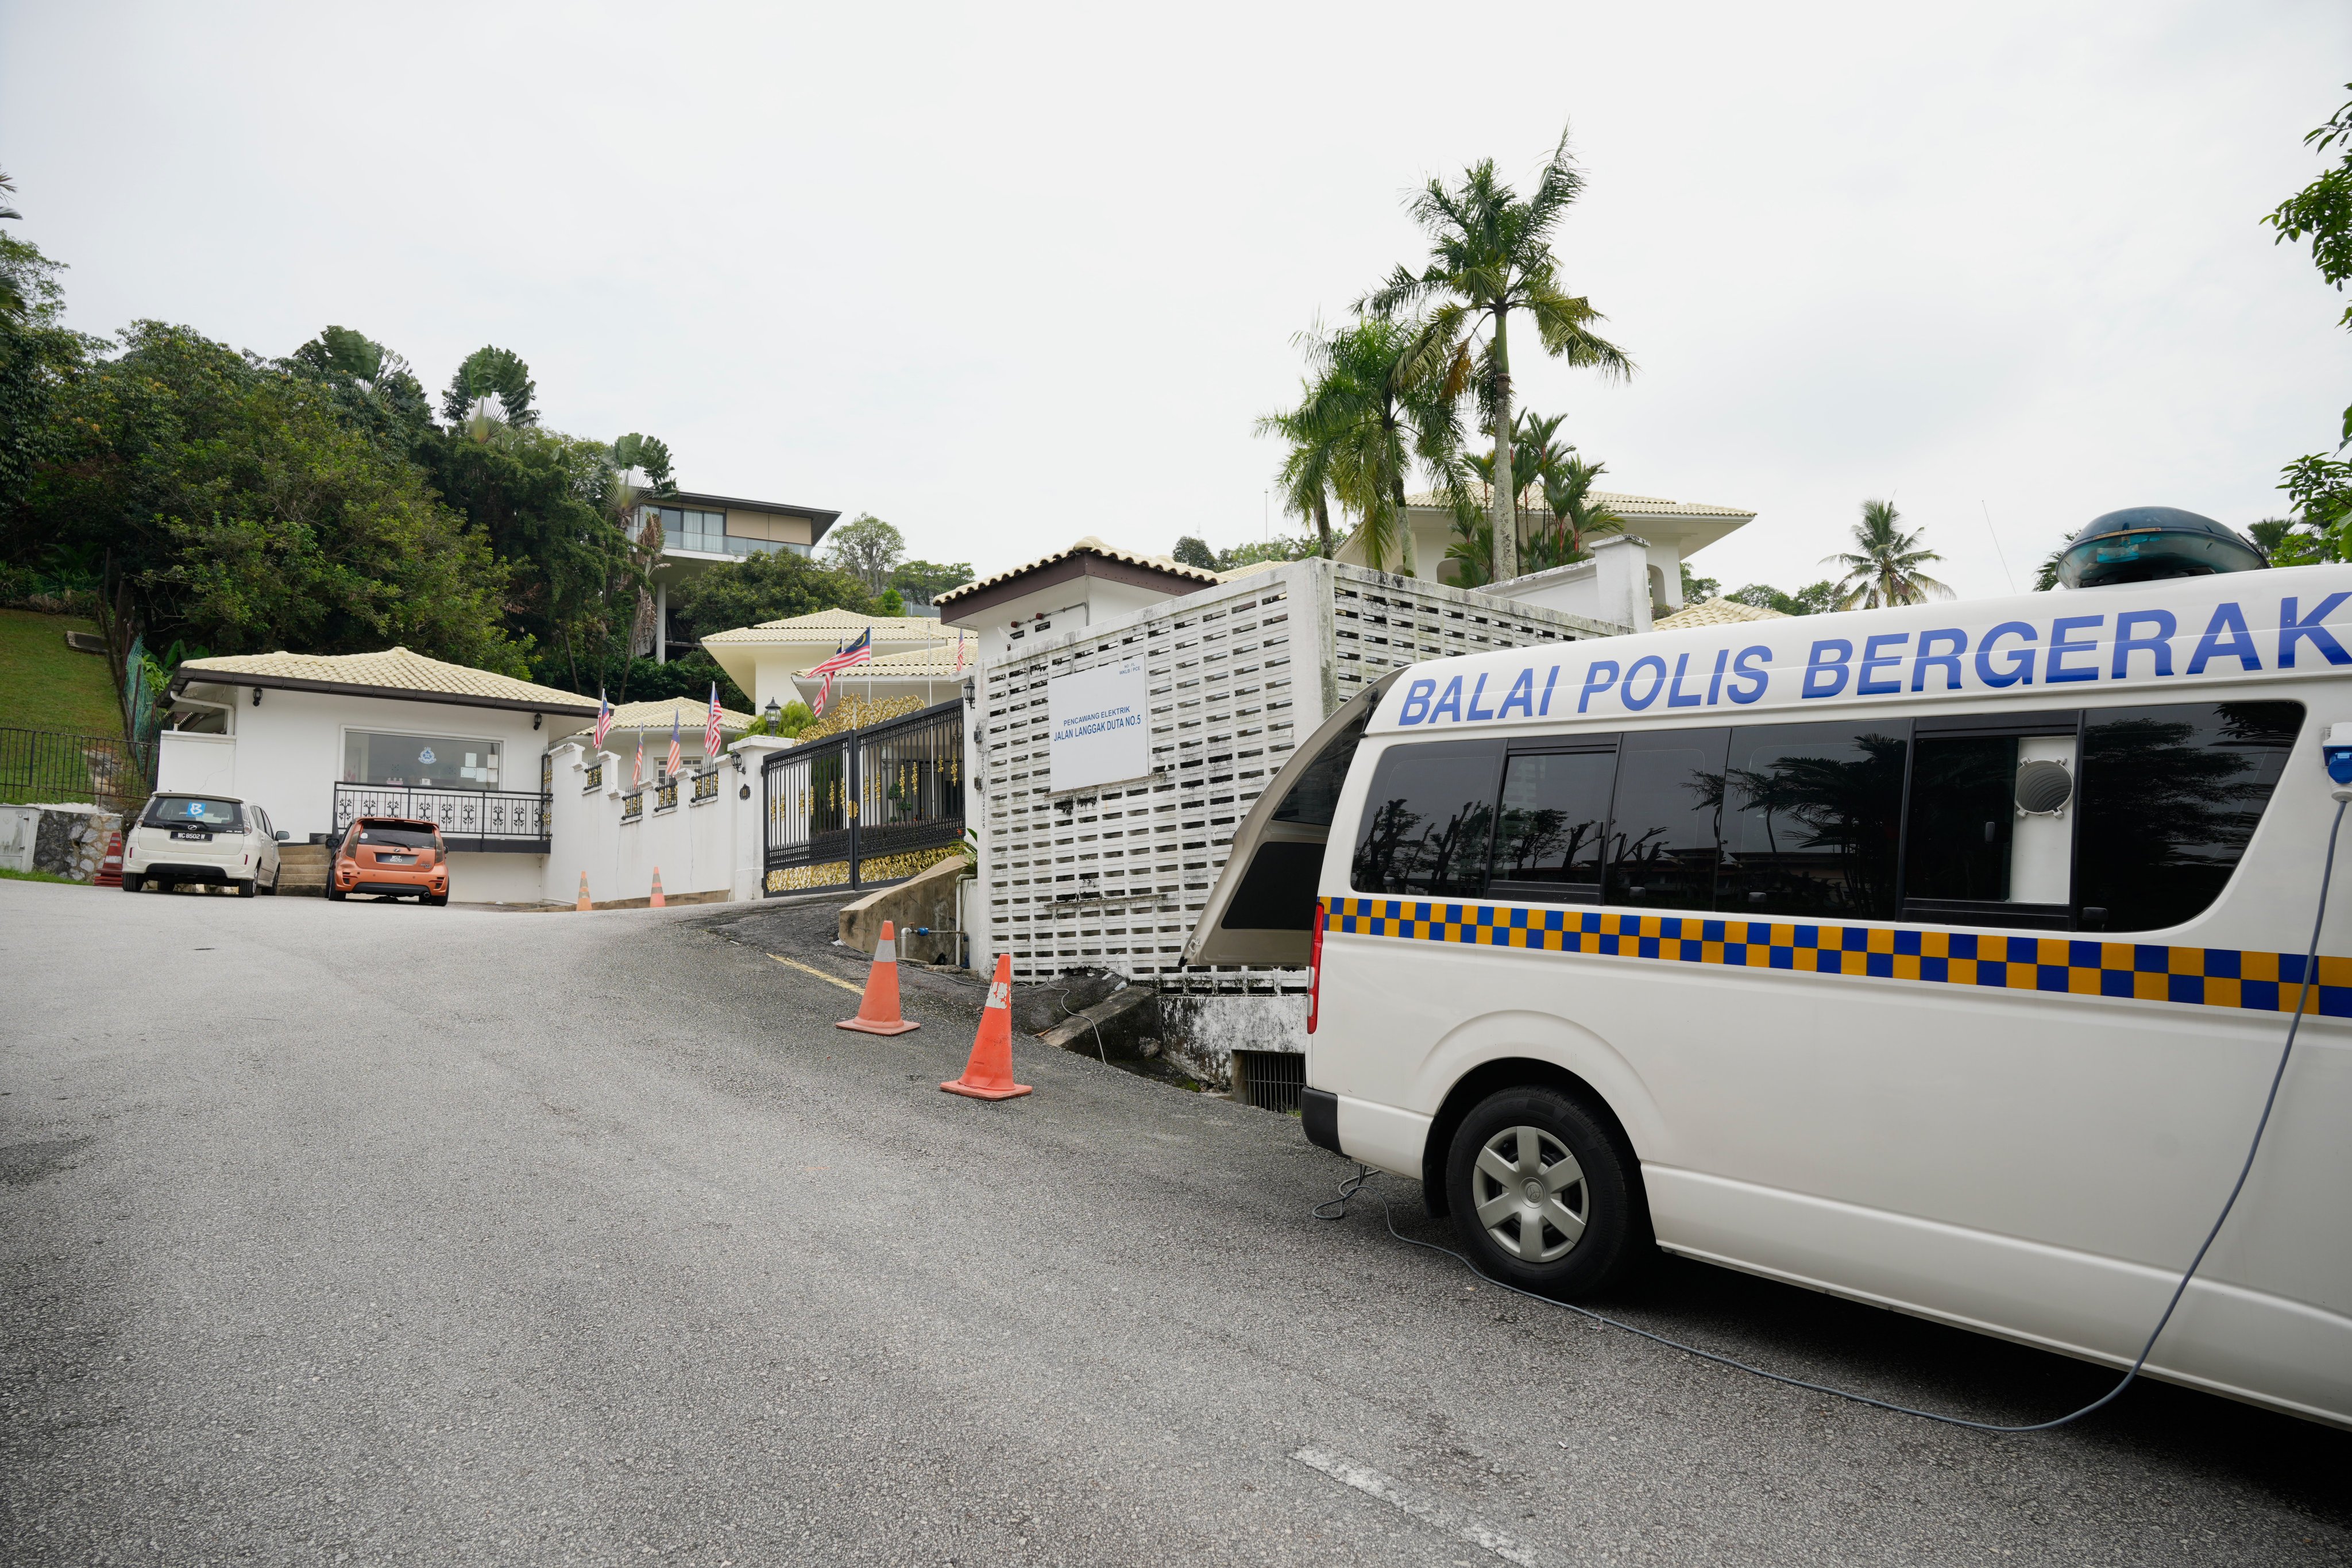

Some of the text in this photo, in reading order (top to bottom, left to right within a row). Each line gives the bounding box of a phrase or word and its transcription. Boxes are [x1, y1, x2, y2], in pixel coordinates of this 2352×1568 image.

[1398, 591, 2352, 727] BALAI POLIS BERGERAK
[1054, 715, 1141, 741] JALAN LANGGAK DUTA NO.5
[1064, 706, 1130, 726] PENCAWANG ELEKTRIK
